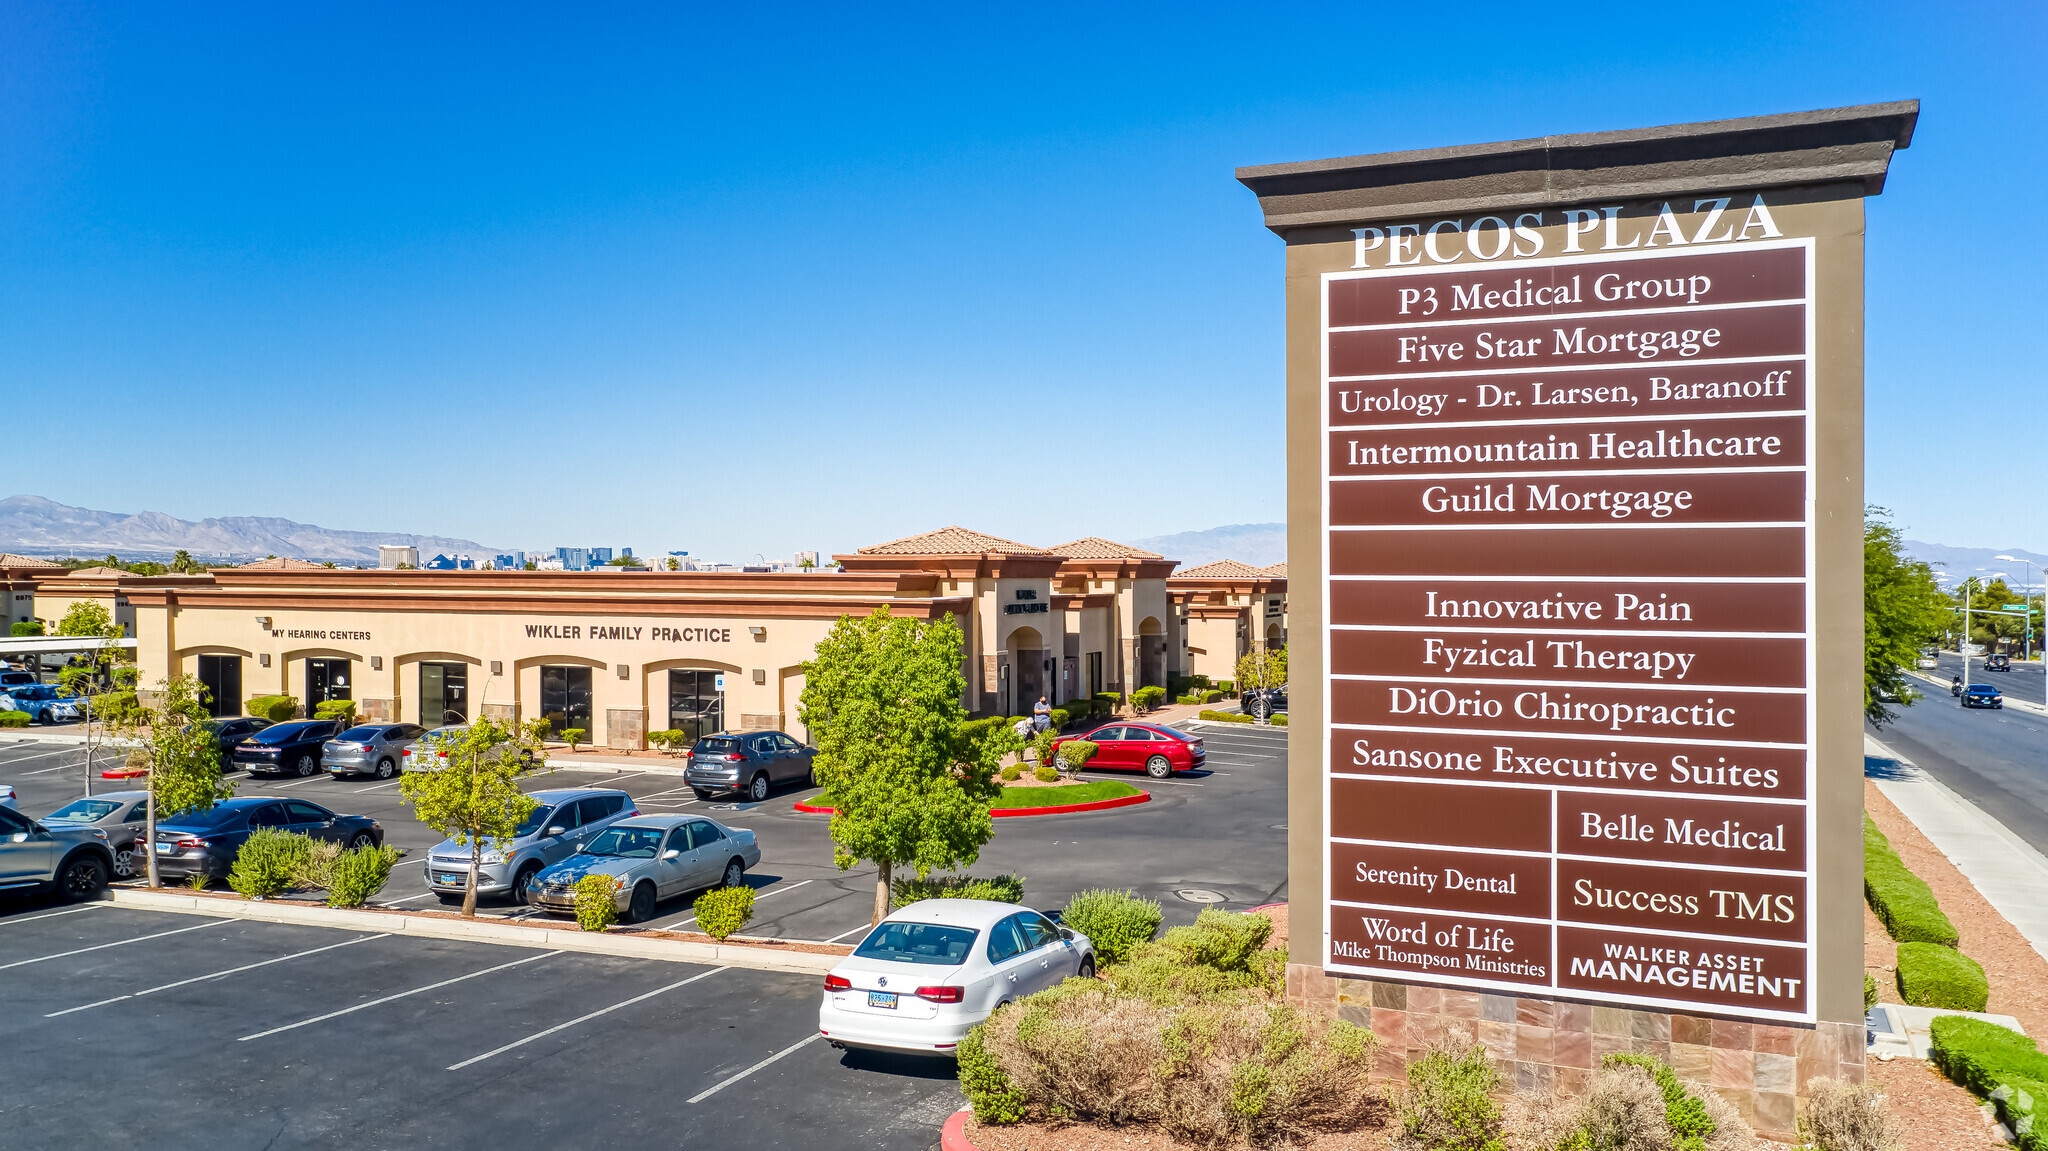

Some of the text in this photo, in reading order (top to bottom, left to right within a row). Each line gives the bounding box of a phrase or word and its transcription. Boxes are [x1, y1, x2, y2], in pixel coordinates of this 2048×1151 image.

[1350, 193, 1784, 270] PECOS PLAZA
[1398, 273, 1712, 316] P3 Medical Group
[1397, 326, 1721, 363] Five Star Mortgage
[1338, 387, 1449, 417] Urology
[1476, 384, 1522, 408] Dr.
[1531, 382, 1639, 407] Larsen,
[1648, 369, 1792, 401] Baranoff
[1347, 428, 1781, 466] Intermountain Healthcare
[1422, 483, 1693, 519] Guild Mortgage
[1424, 591, 1693, 622] Innovative Pain
[272, 629, 371, 641] MY HEARING CENTERS
[525, 624, 731, 643] WIKLER FAMILY PRACTICE
[1422, 638, 1696, 680] Fyzical Therapy
[1388, 687, 1736, 731] DiOrio Chiropractic
[1352, 739, 1779, 789] Sansone Executive Suites
[1580, 811, 1786, 852] Belle Medical
[1355, 861, 1517, 895] Serenity Dental
[1573, 878, 1795, 924] Success TMS
[1361, 916, 1515, 953] Word of Life
[1333, 940, 1546, 978] Mike Thompson Ministries
[1603, 942, 1765, 973] WALKER ASSET
[1570, 956, 1801, 999] MANAGEMENT
